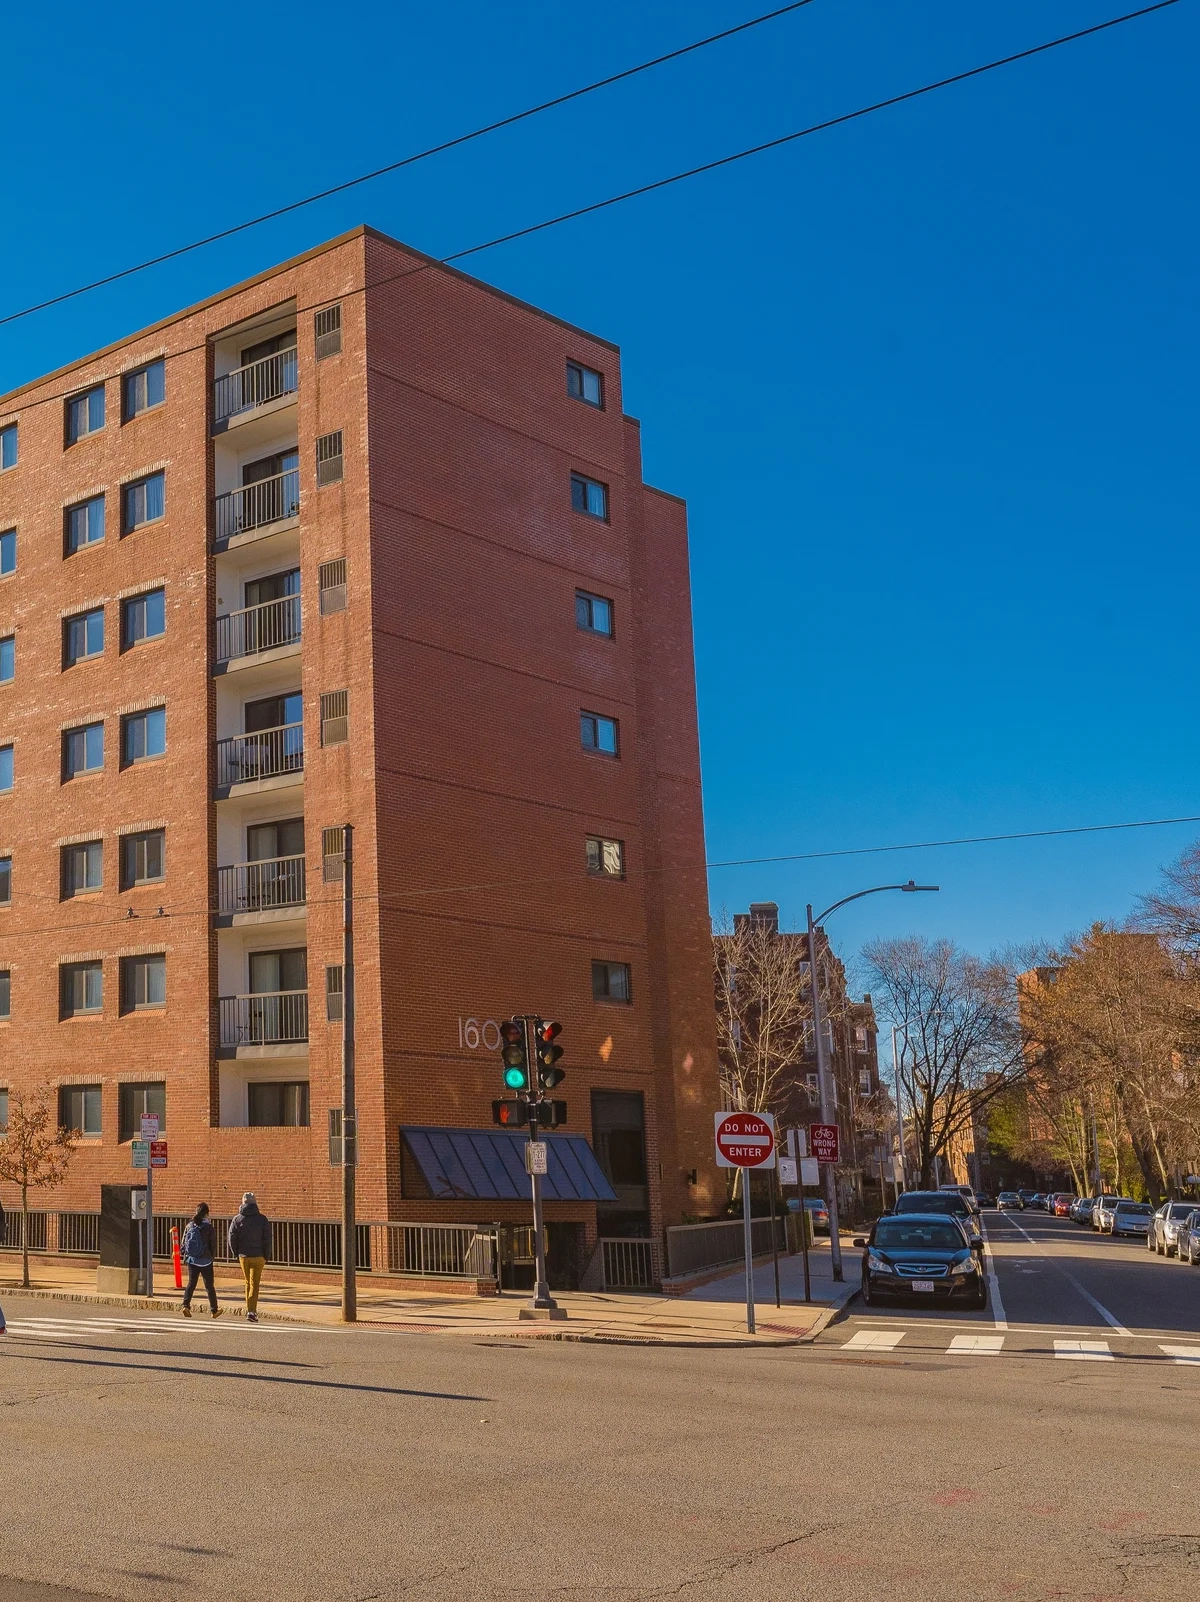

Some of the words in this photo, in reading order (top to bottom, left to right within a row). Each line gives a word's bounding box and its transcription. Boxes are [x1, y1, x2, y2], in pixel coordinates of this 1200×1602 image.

[724, 1123, 739, 1132] DO
[744, 1124, 765, 1133] NOT
[812, 1139, 836, 1148] WRONG
[729, 1147, 762, 1157] ENTER
[817, 1148, 832, 1156] WAY
